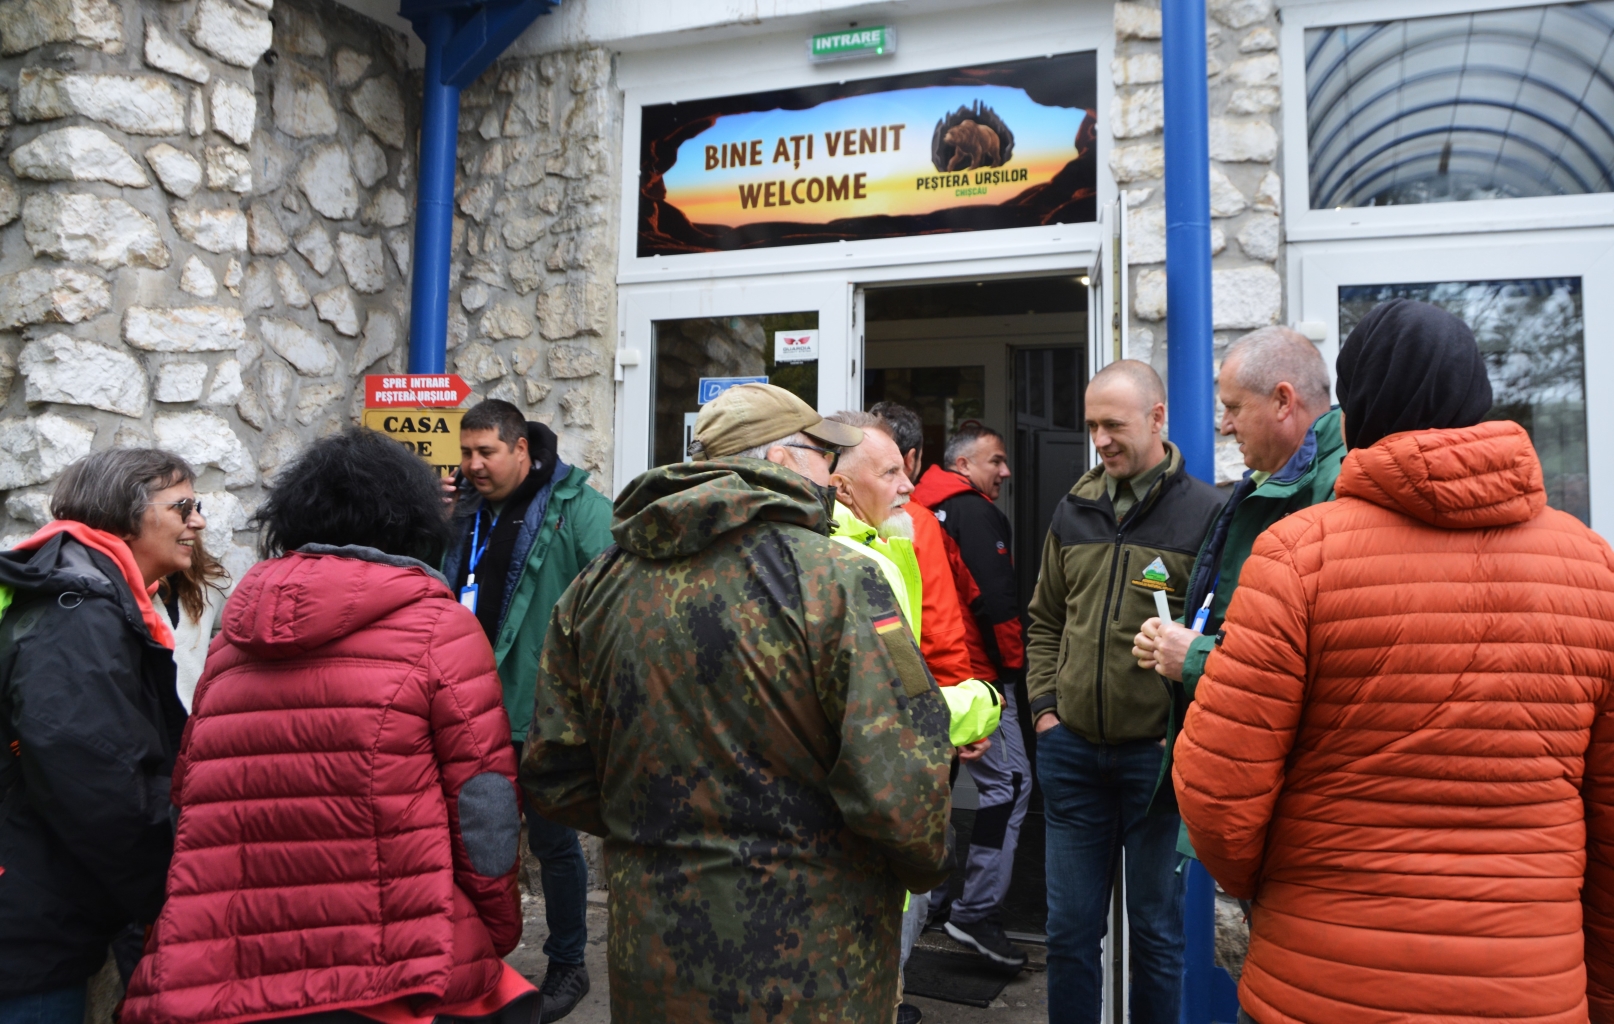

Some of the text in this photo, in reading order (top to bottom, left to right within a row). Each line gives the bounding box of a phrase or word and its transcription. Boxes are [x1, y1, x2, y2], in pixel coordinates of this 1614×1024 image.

[816, 30, 880, 50] INTRARE
[705, 124, 906, 171] BINE AȚI VENIT
[916, 168, 1028, 191] PEȘTERA URȘILOR
[738, 172, 867, 210] WELCOME
[382, 377, 450, 389] SPRE INTRARE
[375, 390, 457, 404] PEȘTERA URȘILOR
[383, 416, 450, 433] CASA
